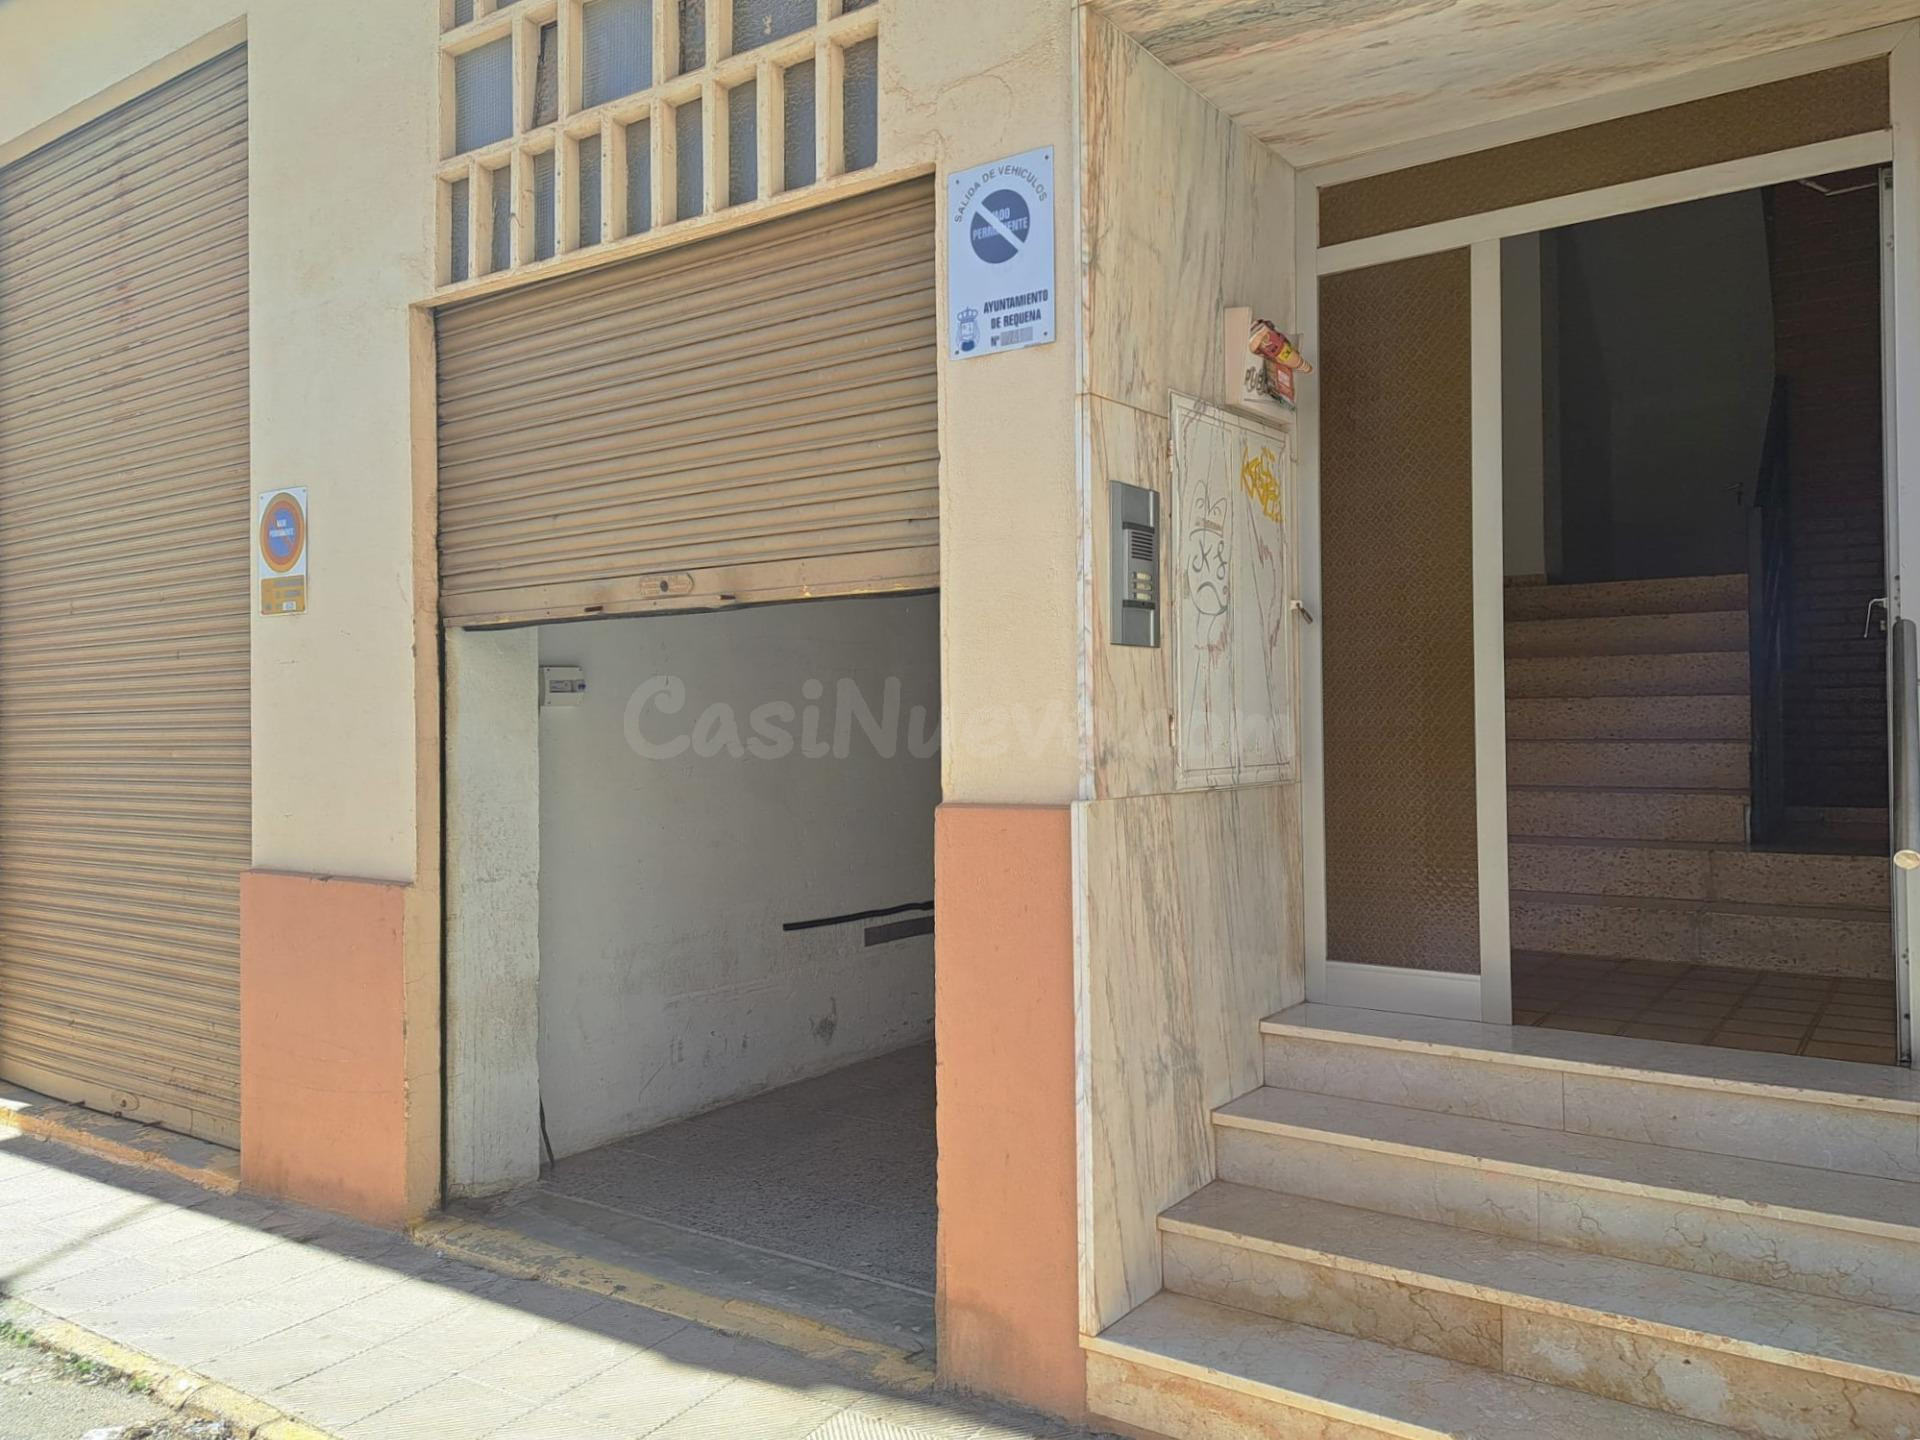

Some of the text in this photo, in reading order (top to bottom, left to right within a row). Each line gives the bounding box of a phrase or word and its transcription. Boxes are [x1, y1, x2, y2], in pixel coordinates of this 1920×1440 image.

[954, 165, 1047, 223] SALIDA DE VEHICULOS
[983, 289, 1049, 314] AYUNTAMIENTO
[991, 309, 1042, 330] DE REQUENA
